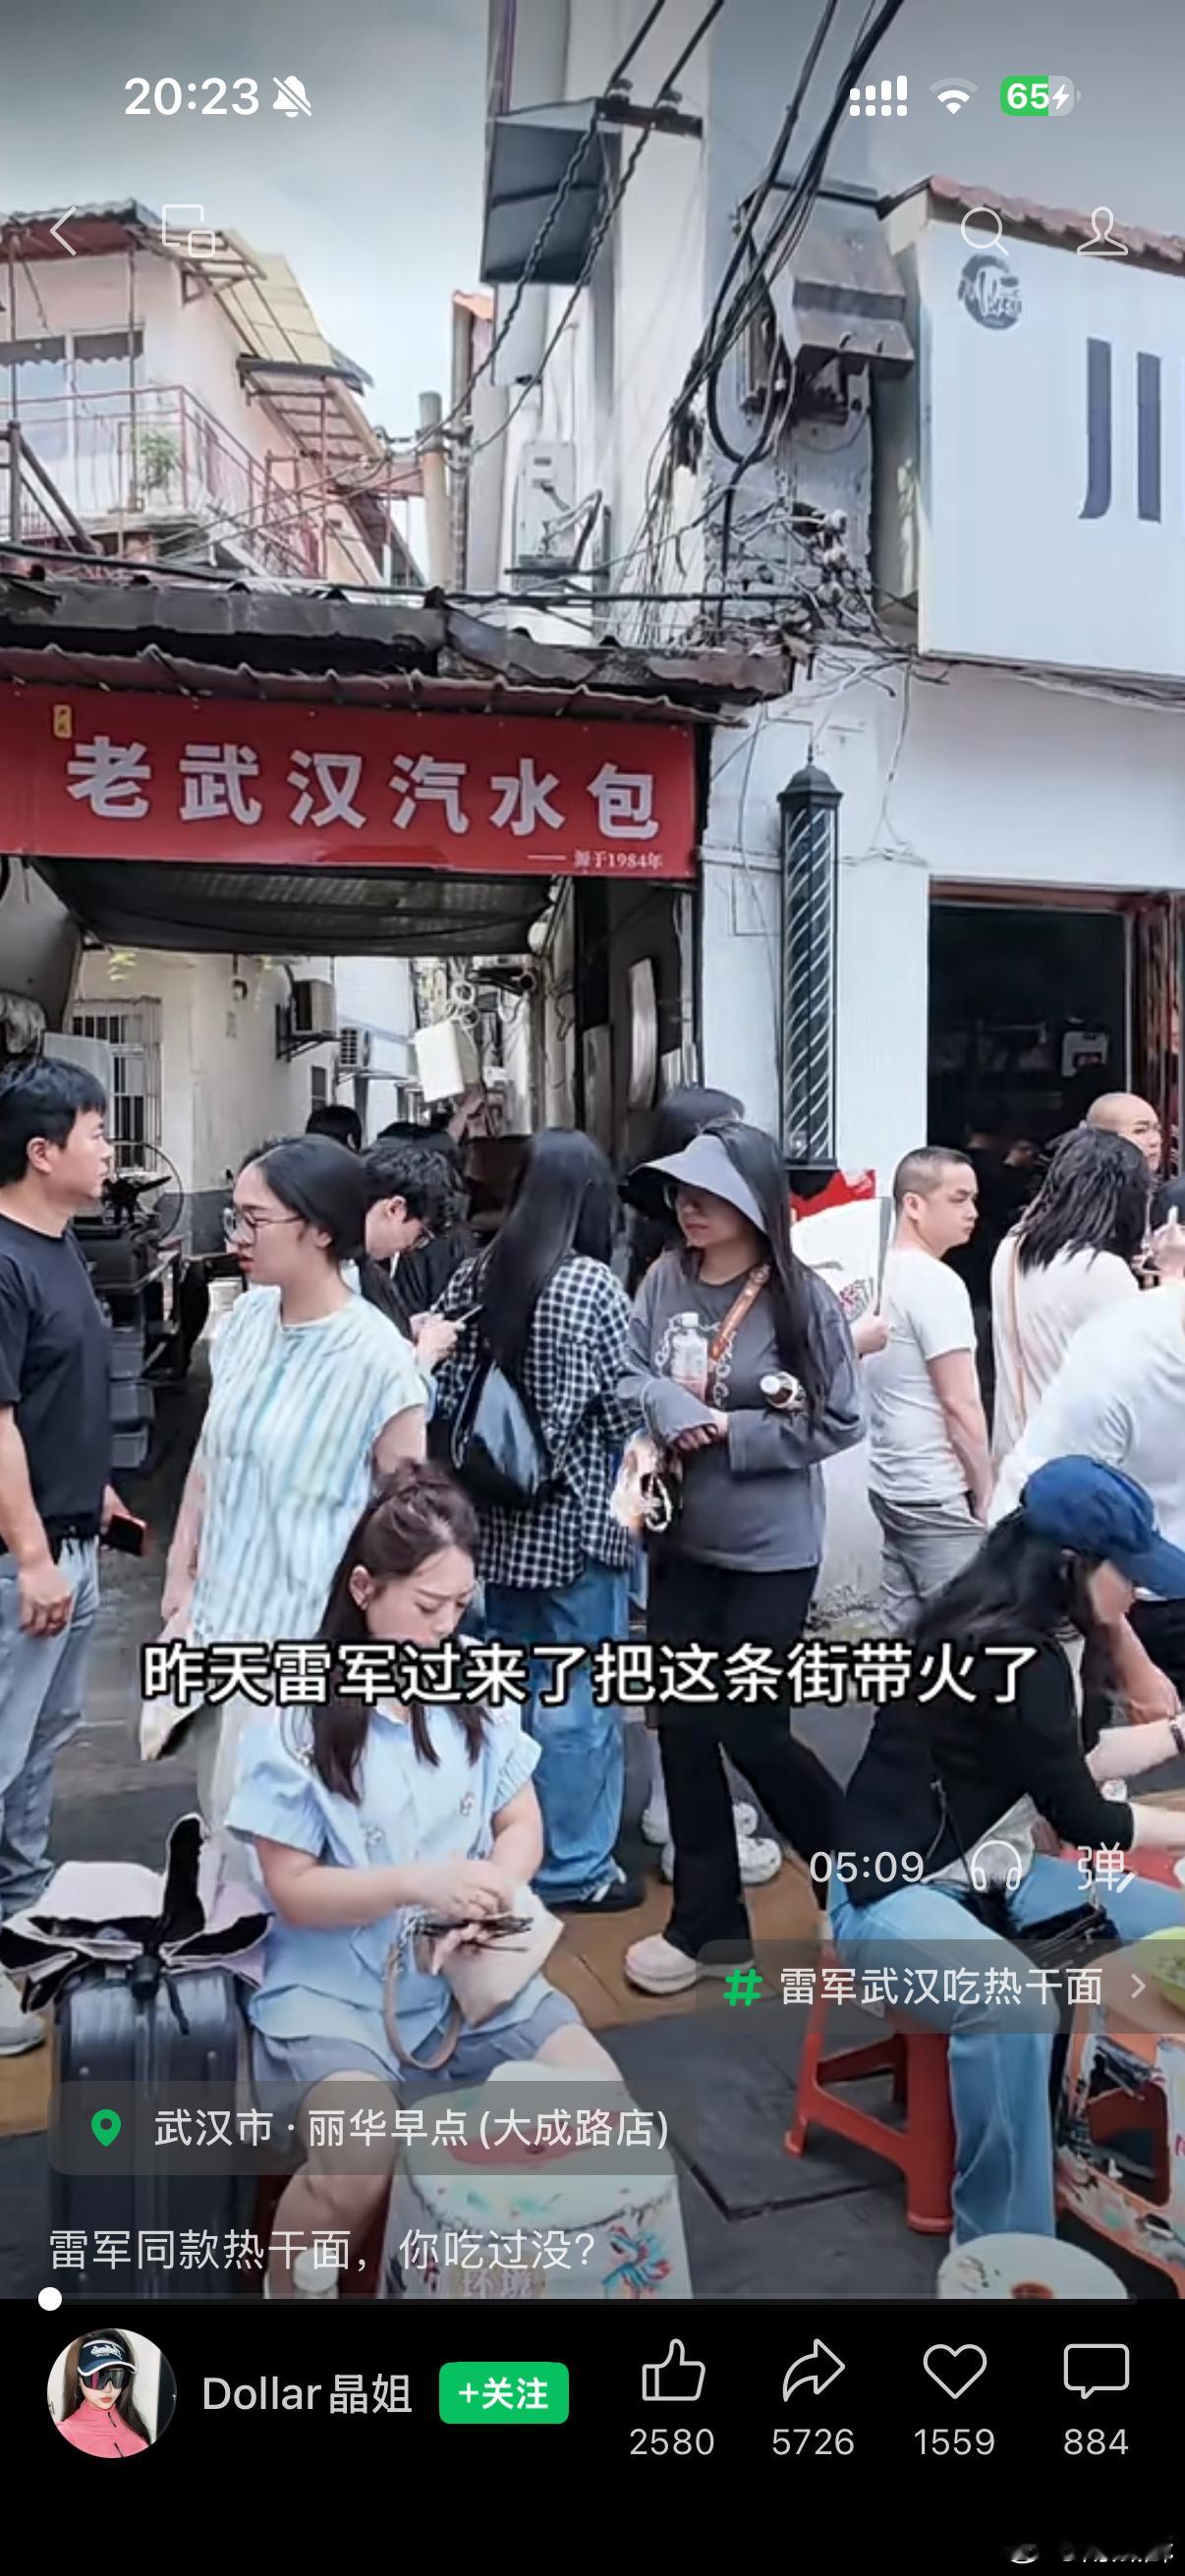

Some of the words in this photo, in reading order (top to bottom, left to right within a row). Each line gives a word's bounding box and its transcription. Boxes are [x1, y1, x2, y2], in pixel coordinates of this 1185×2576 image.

[66, 735, 660, 841] 老武汉汽水包
